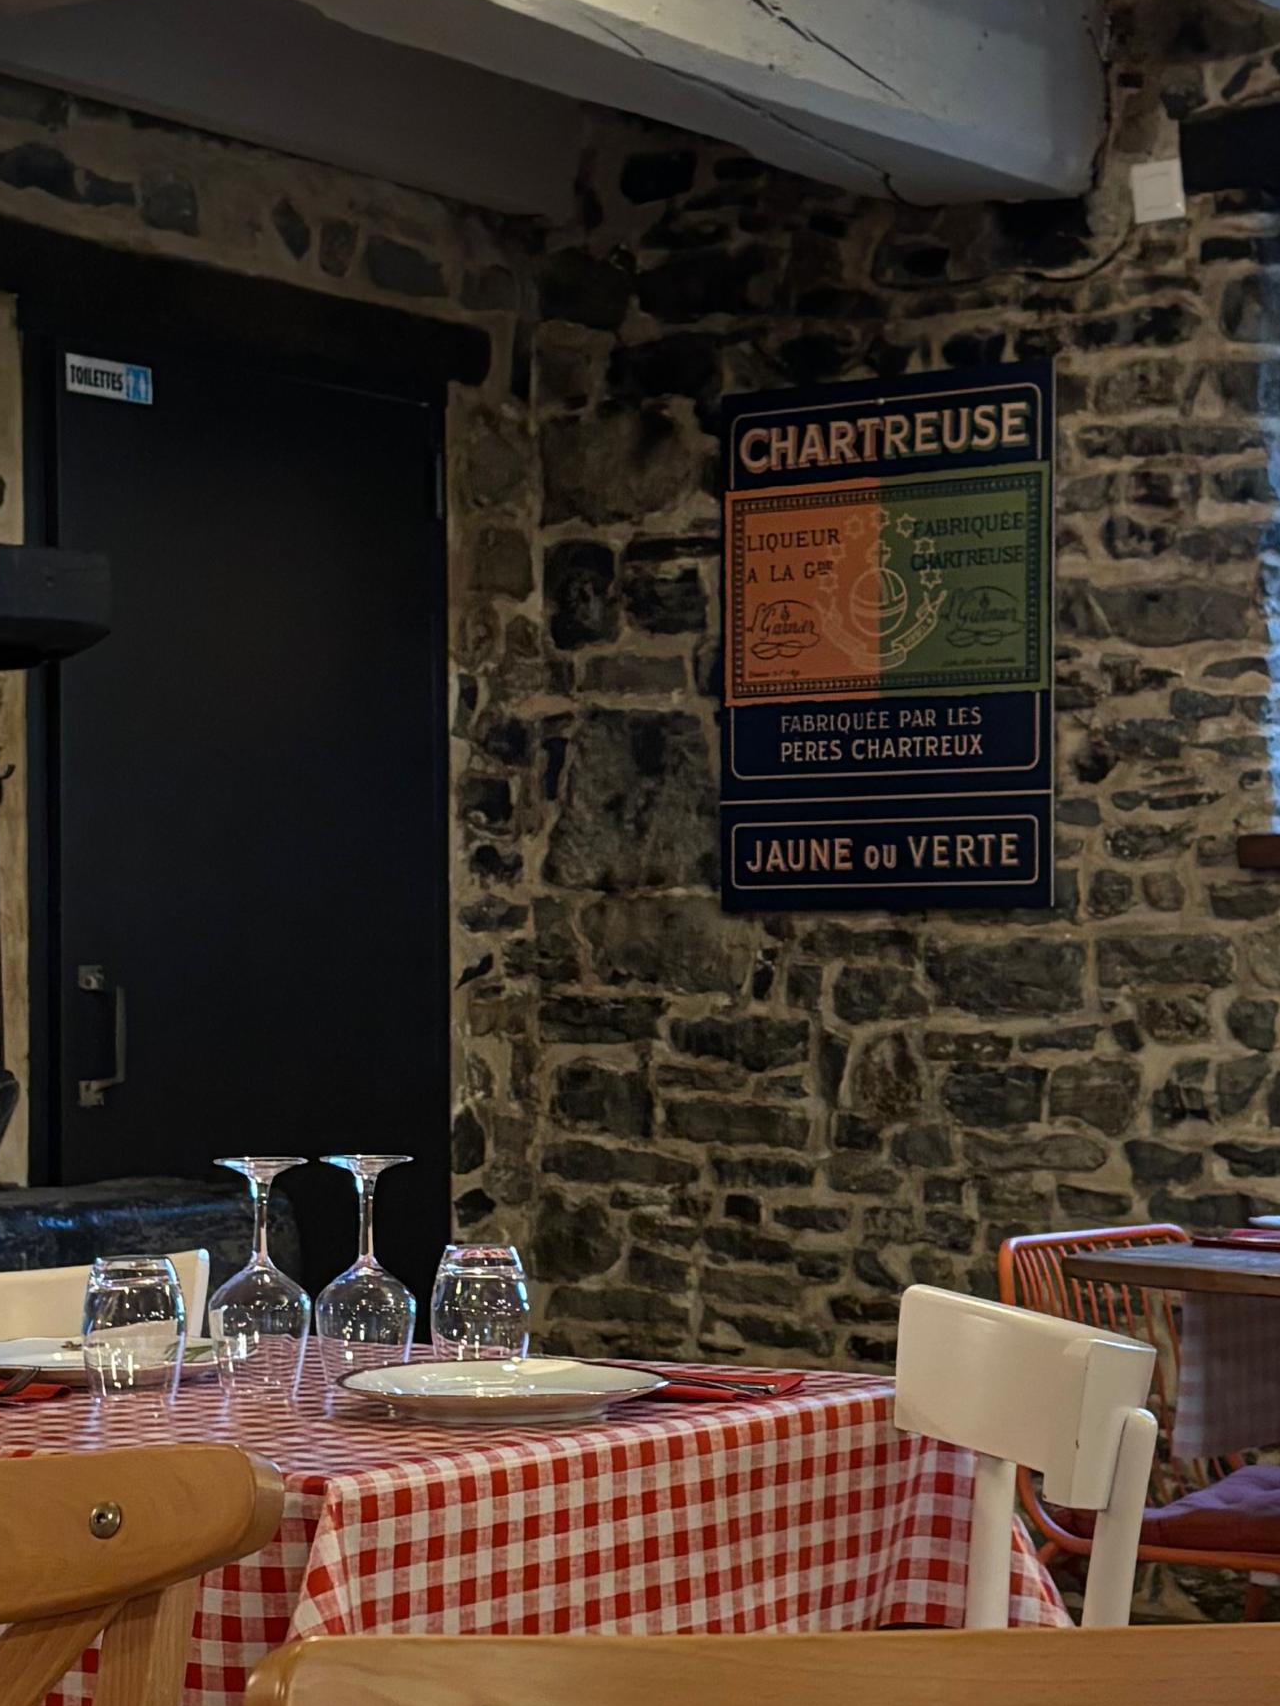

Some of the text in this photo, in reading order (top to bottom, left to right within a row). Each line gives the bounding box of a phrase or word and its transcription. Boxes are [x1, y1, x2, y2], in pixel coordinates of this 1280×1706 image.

[69, 364, 124, 392] TOILETTES
[738, 400, 1032, 476] CHARTREUSE
[746, 528, 841, 553] LIQUEUR
[746, 566, 759, 584] A
[770, 564, 795, 584] LA
[910, 545, 1025, 573] CHARTREUSE
[780, 706, 983, 735] FABRIQUÉE PAR LES
[850, 733, 984, 762] CHARTREUX
[745, 836, 855, 874] JAUNE
[906, 832, 1023, 870] VERTE
